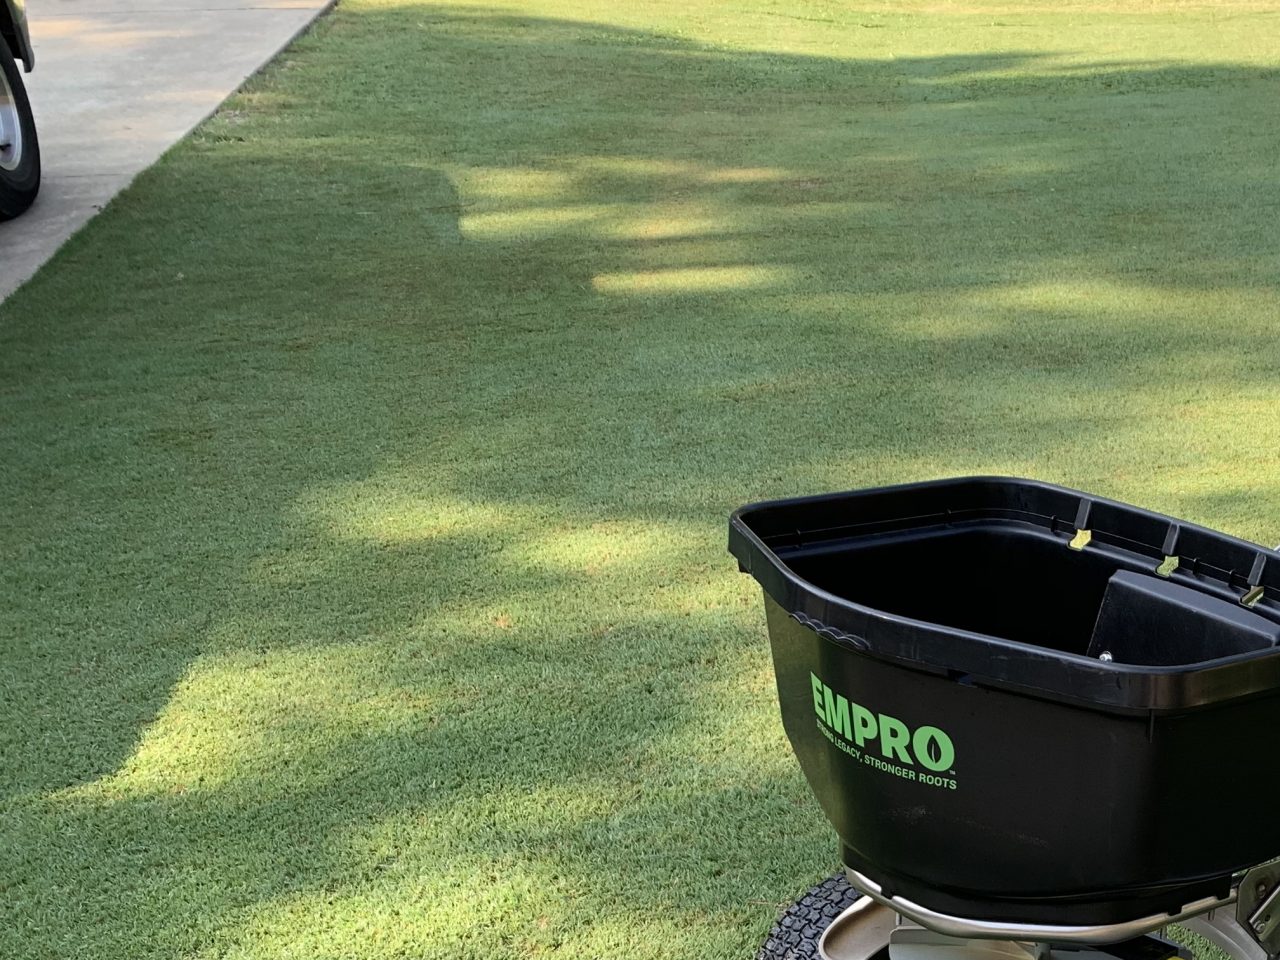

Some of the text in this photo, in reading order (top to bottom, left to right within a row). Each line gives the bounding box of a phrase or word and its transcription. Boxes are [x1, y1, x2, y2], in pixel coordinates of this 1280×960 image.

[810, 671, 955, 772] EMPRO
[834, 737, 863, 763] LEGACY,
[864, 754, 916, 781] STRONGER
[918, 772, 957, 790] ROOTS
